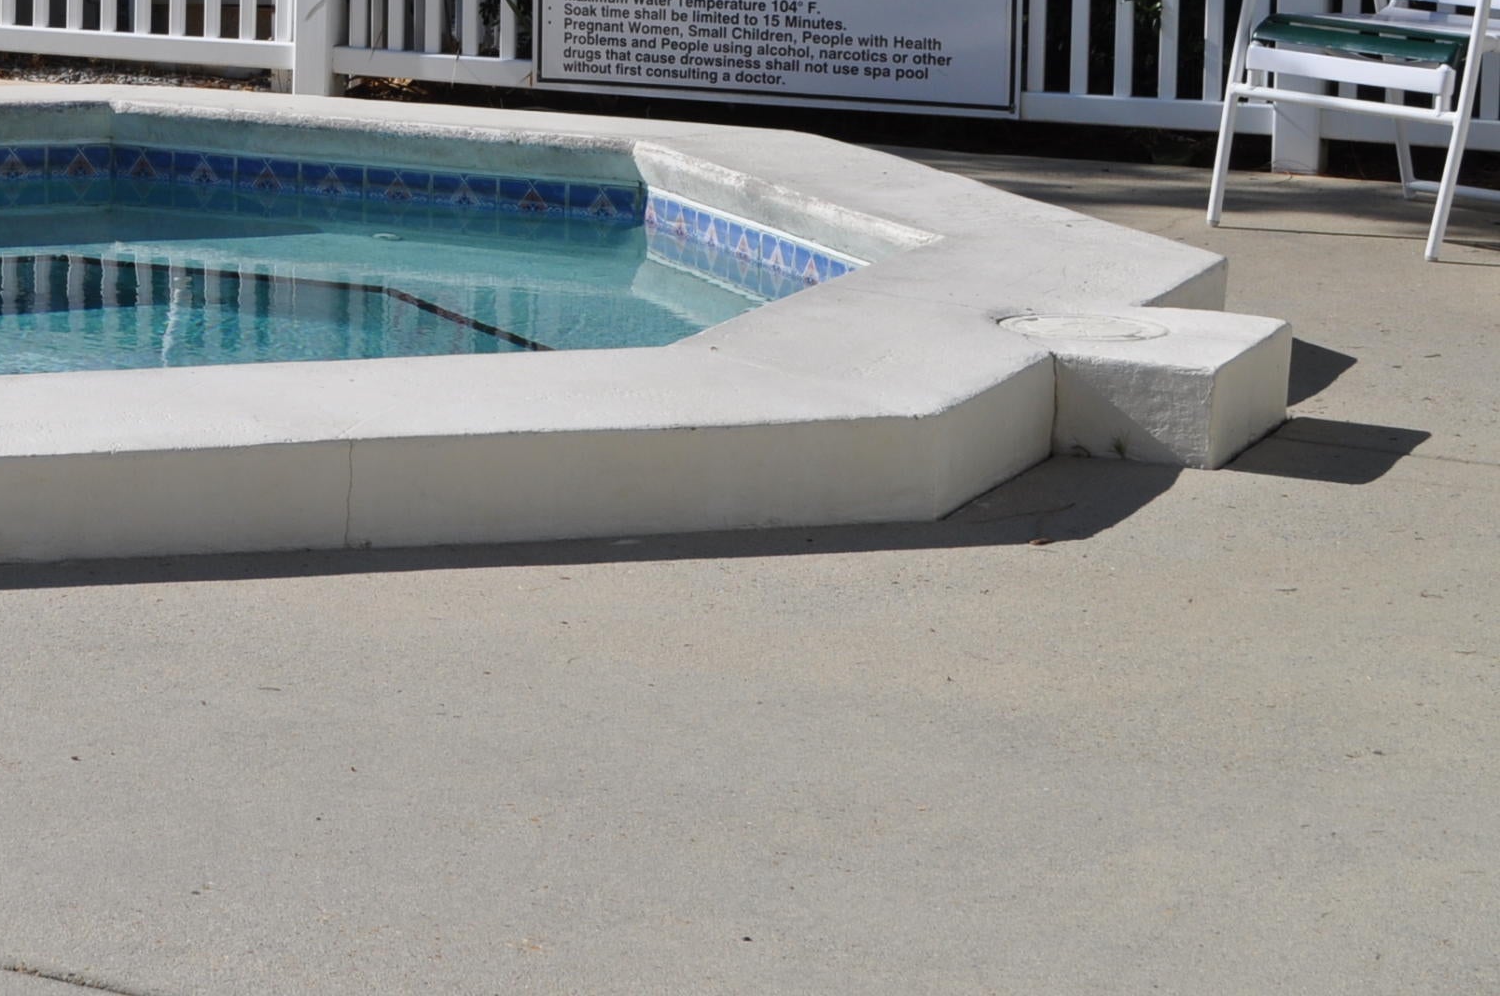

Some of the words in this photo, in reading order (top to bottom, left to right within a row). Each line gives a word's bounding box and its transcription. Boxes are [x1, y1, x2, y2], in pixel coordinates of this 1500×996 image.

[563, 61, 612, 75] without
[615, 63, 642, 77] first
[646, 67, 718, 84] consulting
[723, 72, 731, 82] a
[735, 71, 786, 85] doctor.
